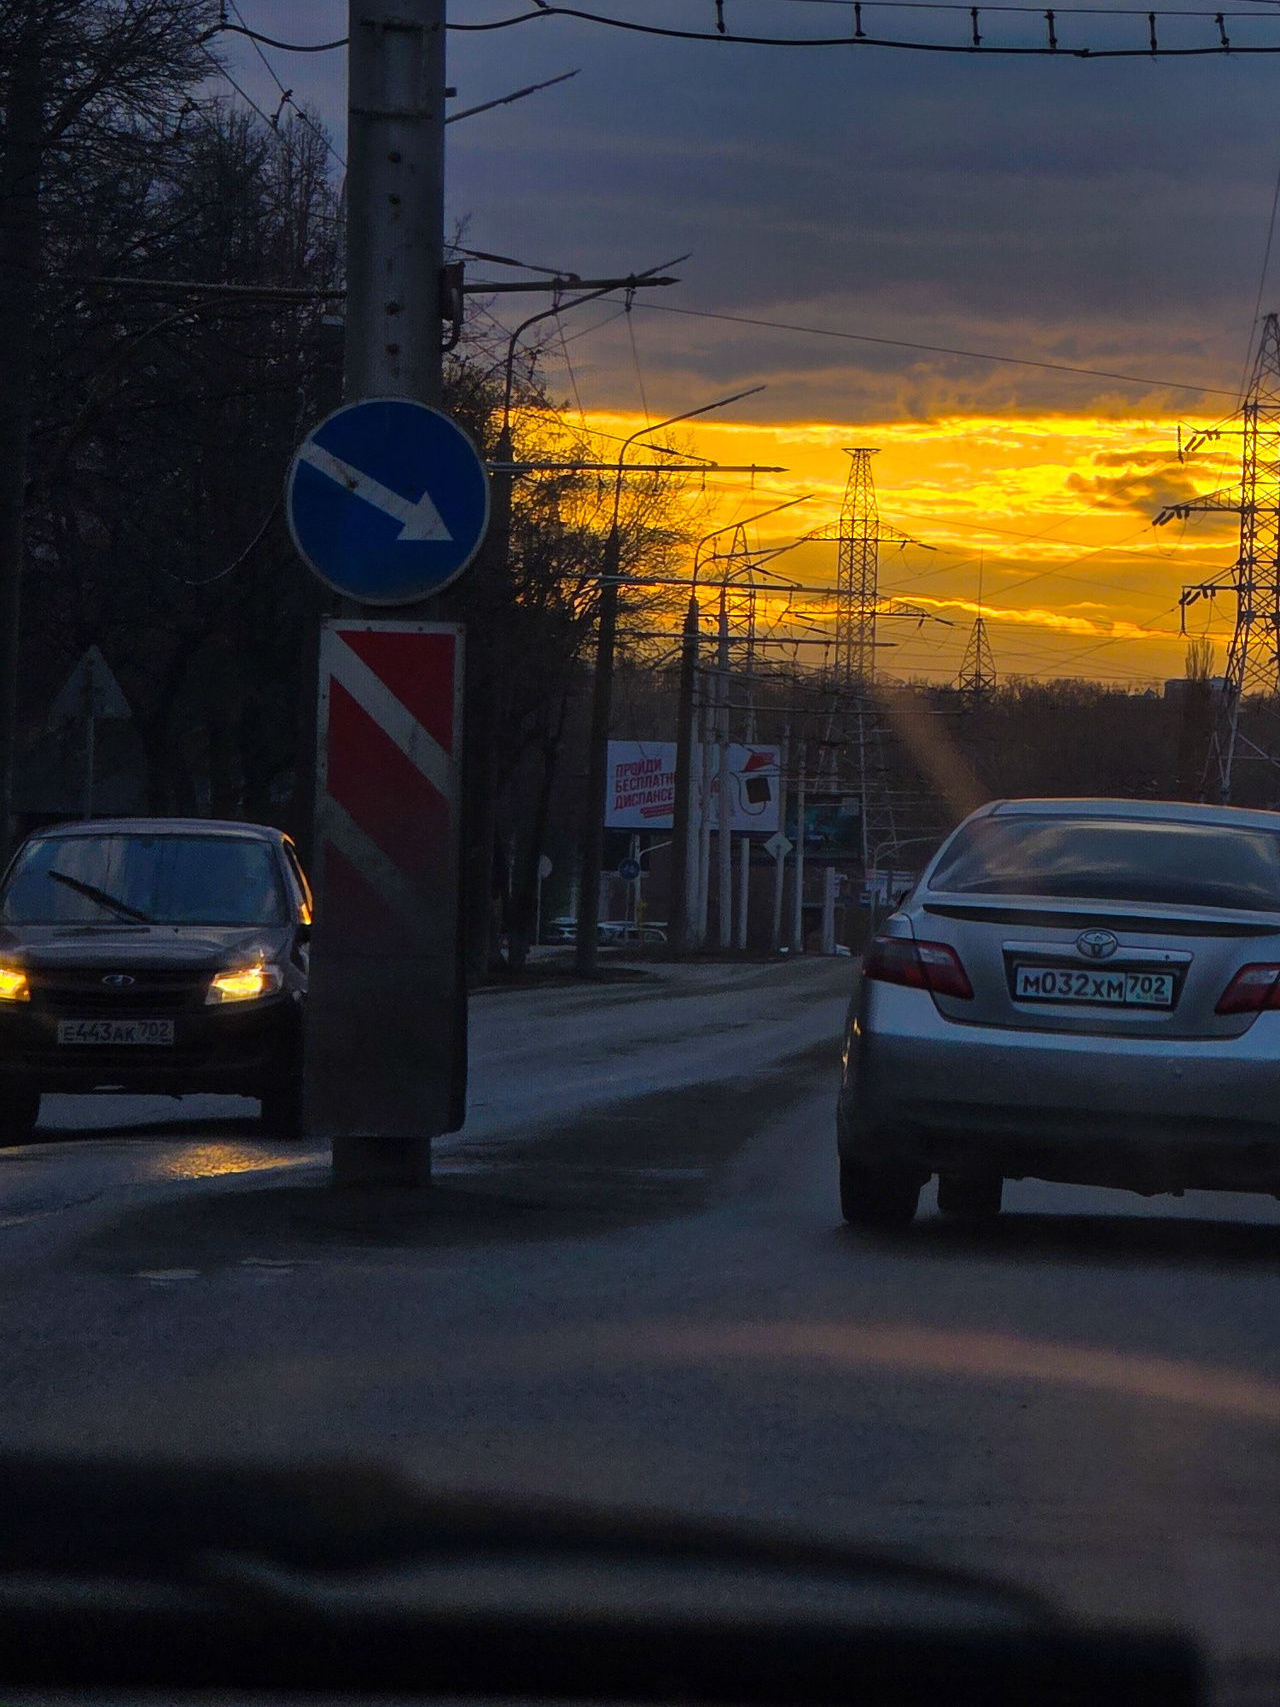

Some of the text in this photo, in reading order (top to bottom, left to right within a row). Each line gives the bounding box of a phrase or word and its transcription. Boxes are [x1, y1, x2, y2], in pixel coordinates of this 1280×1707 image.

[616, 757, 662, 778] ПРОЙДИ
[615, 772, 676, 793] БЕСПЛАТН
[614, 787, 674, 810] ДИСПАНСЕ
[1128, 975, 1166, 995] 702
